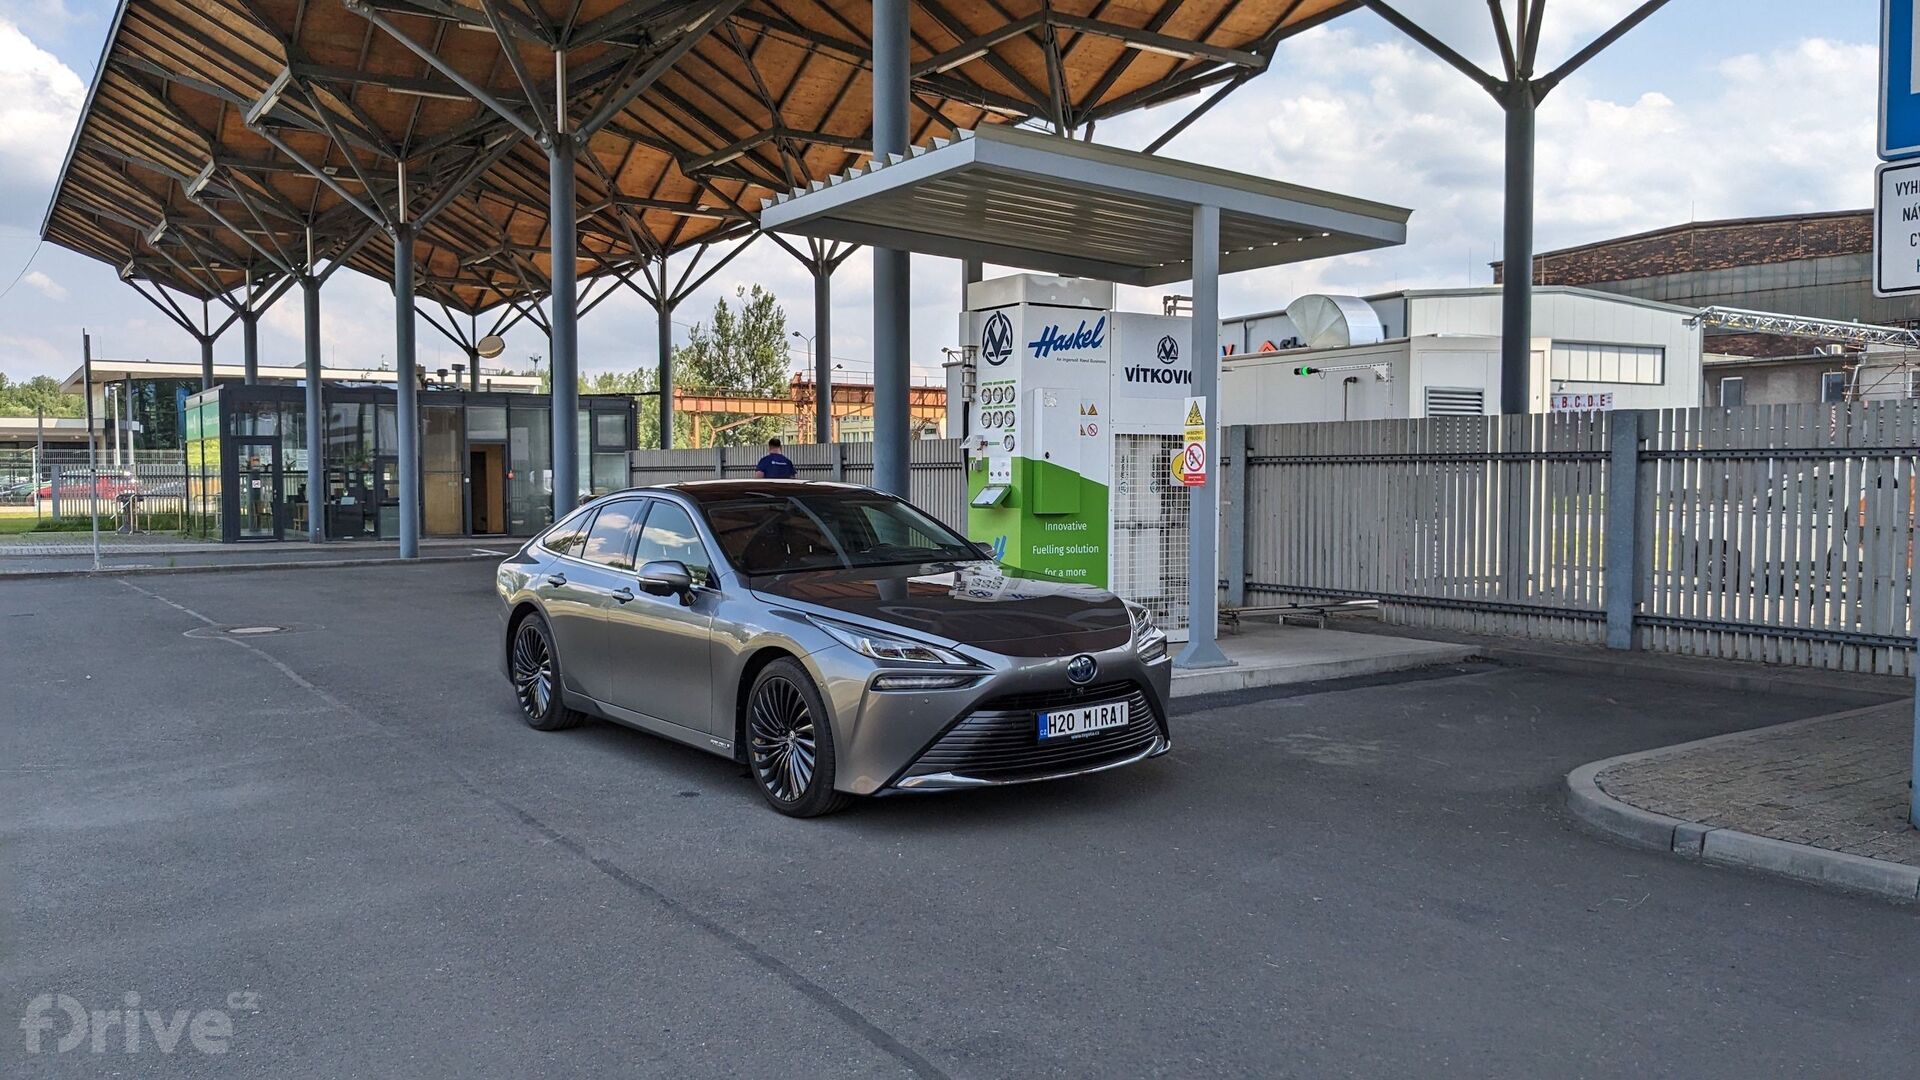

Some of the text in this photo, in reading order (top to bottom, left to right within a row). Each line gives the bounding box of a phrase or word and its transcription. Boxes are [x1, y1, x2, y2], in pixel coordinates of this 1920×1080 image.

[1895, 180, 1920, 197] VYH
[1902, 202, 1920, 222] NÁ
[1027, 315, 1106, 359] Haskel
[1574, 395, 1581, 408] C
[1587, 394, 1594, 407] D
[1600, 394, 1605, 407] E
[1045, 521, 1088, 531] Innovative
[1032, 543, 1099, 557] Fuelling solution
[1045, 567, 1087, 577] for a more
[1083, 704, 1124, 729] MIRAI
